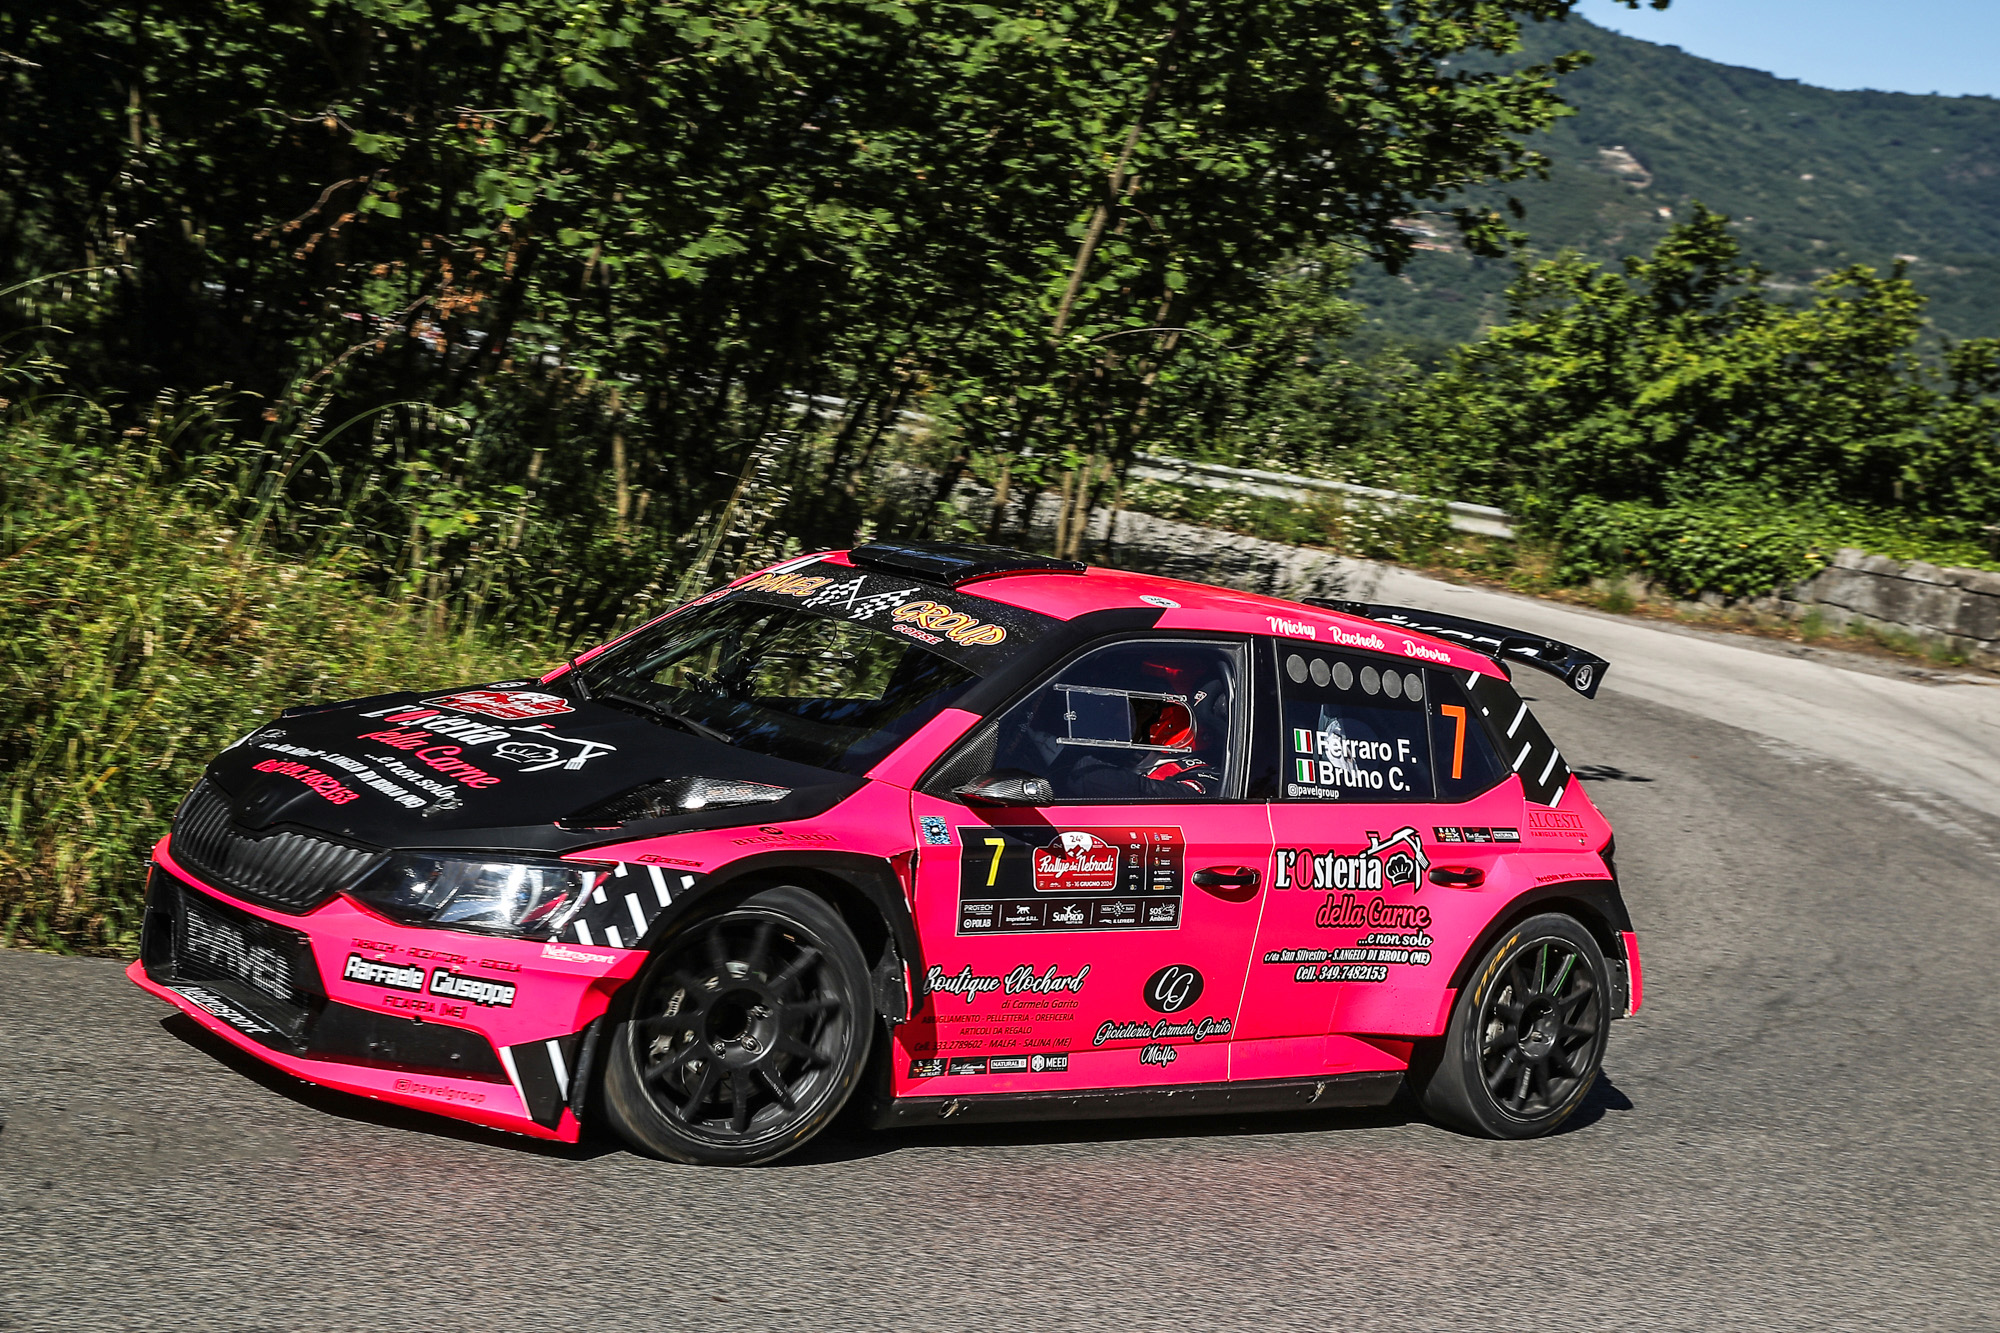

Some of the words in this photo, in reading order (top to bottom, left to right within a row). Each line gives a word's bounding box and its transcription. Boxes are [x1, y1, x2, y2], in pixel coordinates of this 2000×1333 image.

[891, 601, 1007, 646] GROUP
[892, 624, 945, 645] CORSE
[1266, 616, 1316, 639] Michy
[1328, 626, 1384, 650] Rachele
[1402, 639, 1451, 663] Debora
[1316, 730, 1392, 762] Ferraro
[1397, 738, 1417, 764] F.
[1441, 704, 1466, 780] 7
[415, 745, 502, 789] Carne
[1319, 760, 1384, 790] Bruno
[1388, 766, 1411, 792] C.
[385, 761, 424, 784] non
[415, 778, 459, 799] solo
[1298, 785, 1340, 799] pavelgroup
[1529, 812, 1585, 829] ALCESTI
[983, 837, 1005, 886] 7
[1037, 855, 1069, 879] Rallye
[1076, 855, 1114, 872] Nebrodi
[1275, 850, 1382, 890] L'Osteria
[971, 918, 991, 928] POLAB
[1149, 907, 1161, 916] SOS
[1317, 895, 1364, 926] della
[1368, 898, 1431, 927] Carne
[1376, 934, 1401, 946] non
[1402, 930, 1433, 947] solo
[541, 943, 616, 964] Nebrosport
[1280, 951, 1295, 962] San
[1296, 949, 1327, 962] Silvestro
[1333, 949, 1366, 961] S.ANGELO
[1367, 950, 1377, 961] DI
[1378, 950, 1409, 963] BROLO
[1410, 951, 1431, 965] (ME)
[343, 955, 426, 990] Raffaele
[429, 970, 517, 1005] Giuseppe
[922, 965, 1000, 1004] Boutique
[1004, 965, 1091, 995] Clochard
[1296, 965, 1316, 981] Cell.
[1319, 965, 1388, 981] 349.7482153
[1155, 966, 1194, 1012] CG
[178, 985, 272, 1033] Nebrosport
[1001, 999, 1010, 1009] di
[1012, 999, 1049, 1009] Carmela
[1051, 998, 1079, 1008] Garito
[986, 1013, 1030, 1023] PELLETTERIA
[1035, 1013, 1074, 1022] OREFICERIA
[959, 1027, 991, 1036] ARTICOLI
[993, 1027, 1003, 1035] DA
[1004, 1026, 1033, 1035] REGALO
[1093, 1022, 1151, 1046] Gioielleria
[1152, 1020, 1196, 1039] Carmela
[1194, 1018, 1232, 1041] Garito
[932, 1040, 983, 1050] 333.2789602
[989, 1039, 1017, 1048] MALFA
[1023, 1039, 1051, 1048] SALINA
[1052, 1038, 1072, 1048] (ME)
[1141, 1045, 1177, 1067] Malfa
[1046, 1056, 1068, 1068] MEED
